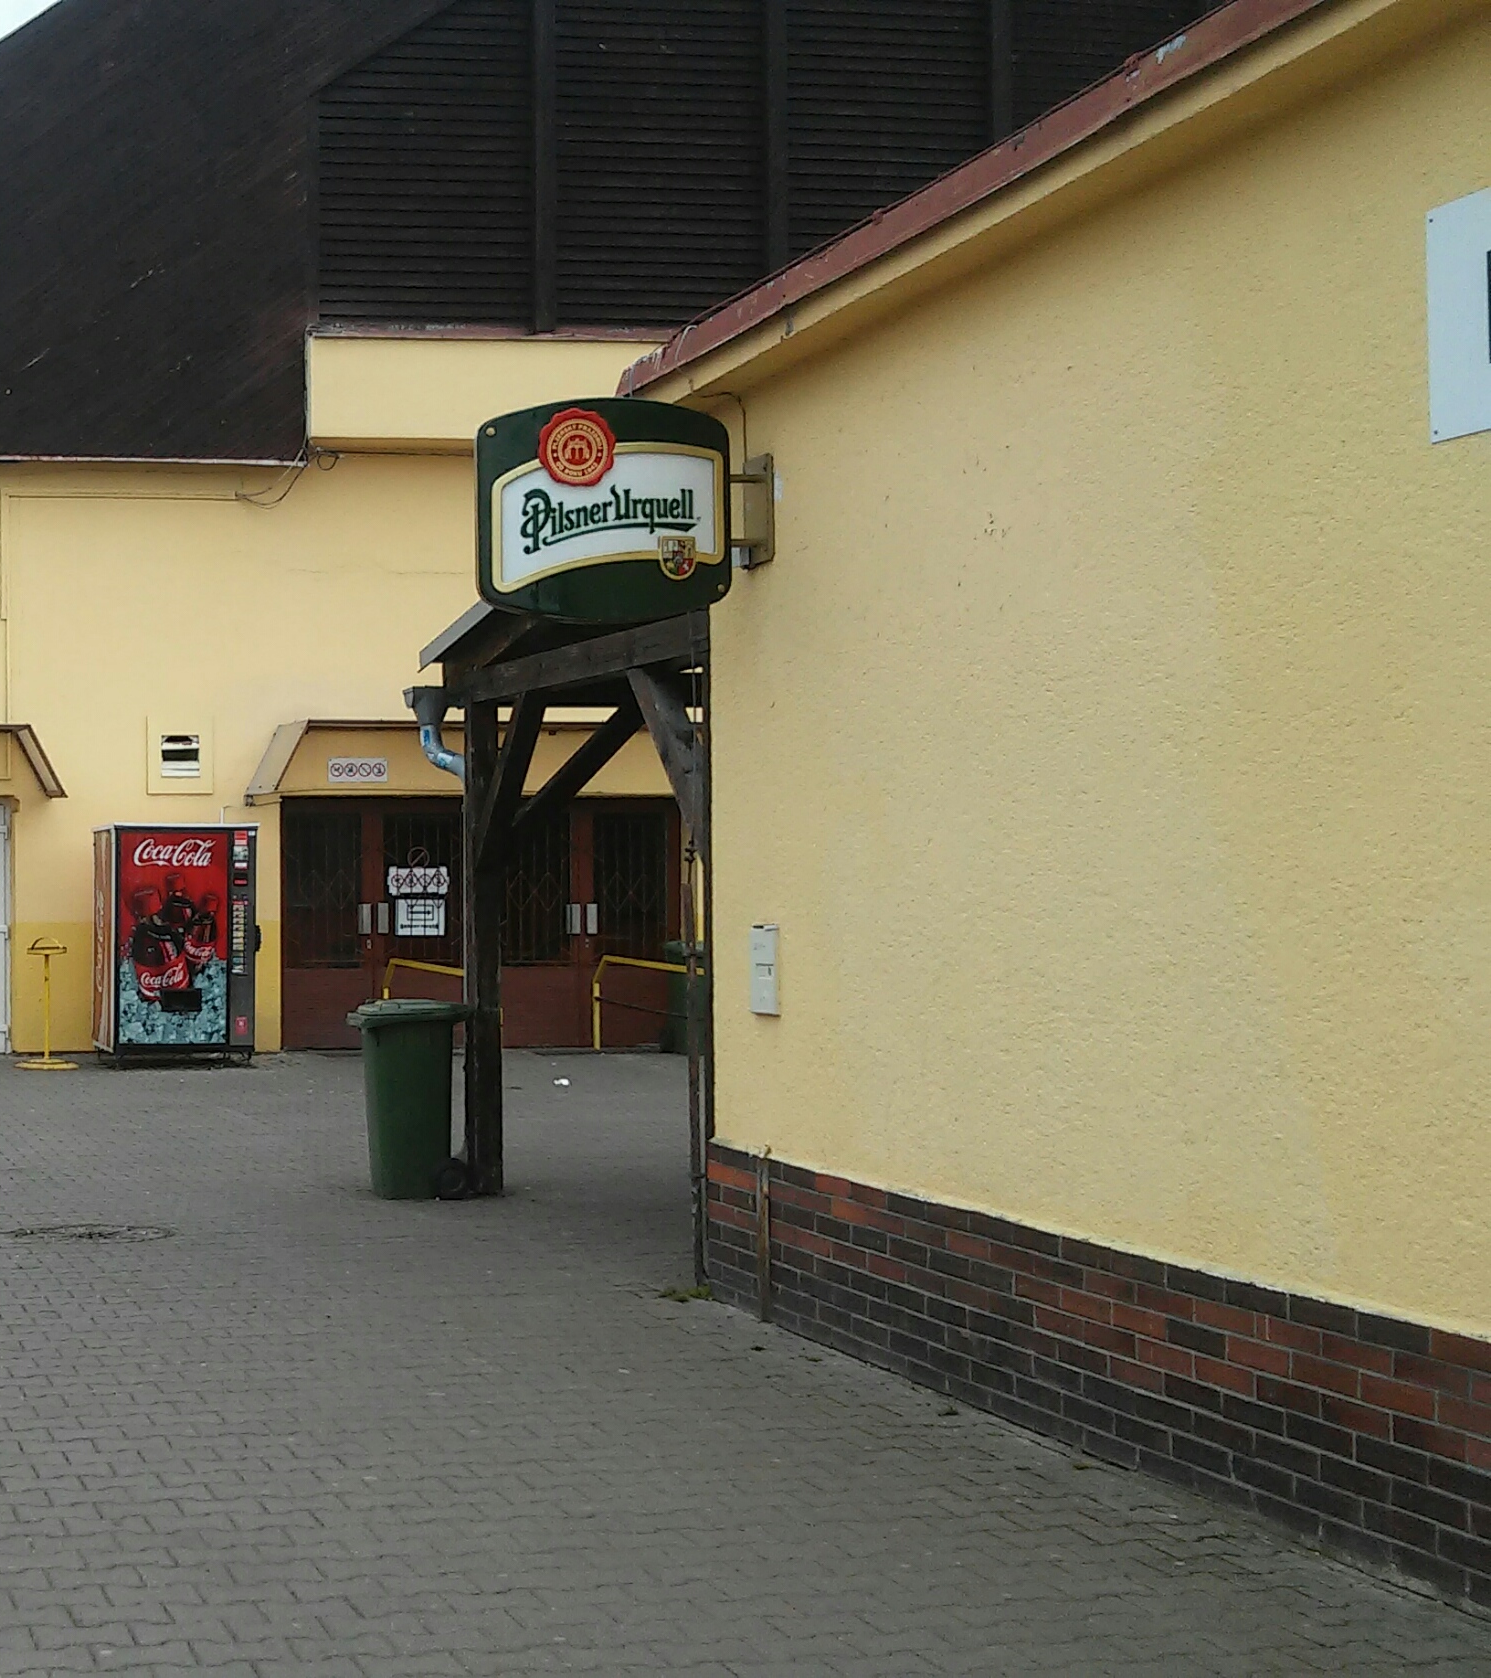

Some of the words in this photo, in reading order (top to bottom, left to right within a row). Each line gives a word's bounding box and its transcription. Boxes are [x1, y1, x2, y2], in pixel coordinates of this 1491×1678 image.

[520, 488, 613, 555] Pilsner
[610, 484, 694, 535] Urquell
[133, 838, 216, 867] Coca-Cola
